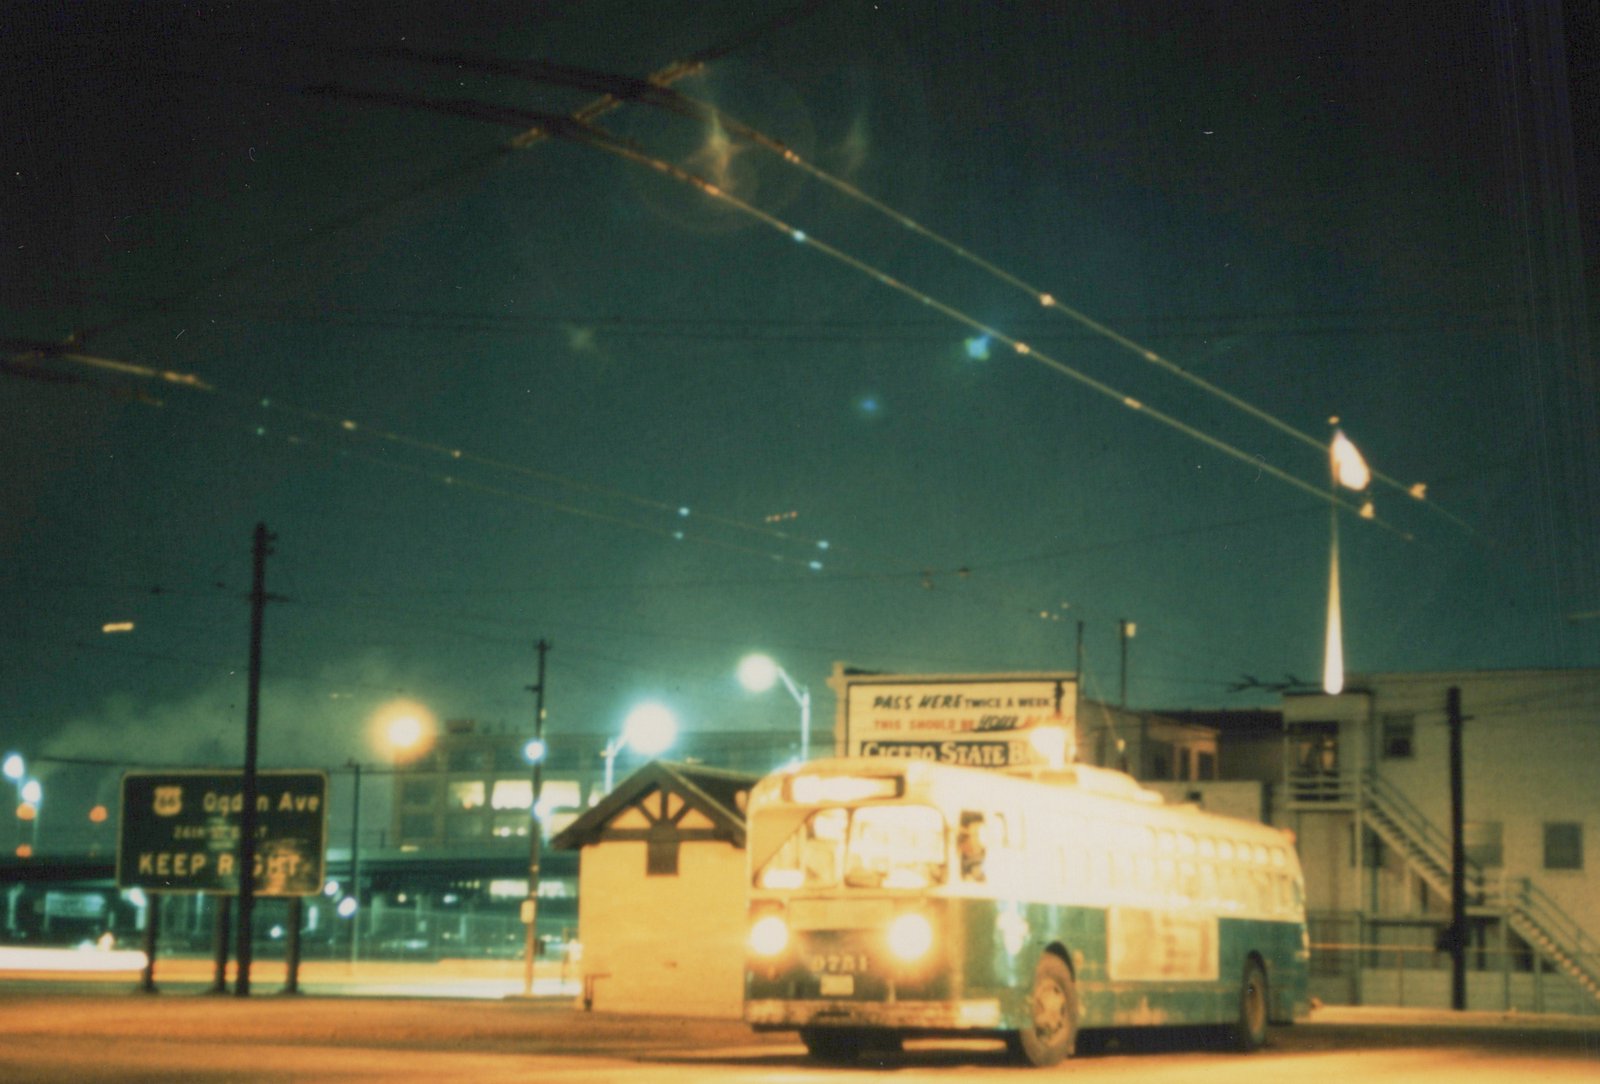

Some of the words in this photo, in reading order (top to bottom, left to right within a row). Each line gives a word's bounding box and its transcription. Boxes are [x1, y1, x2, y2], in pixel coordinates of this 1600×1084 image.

[873, 695, 912, 710] PASS
[918, 694, 964, 710] HERE
[965, 698, 1002, 709] TWICE
[1005, 698, 1014, 708] A
[1018, 697, 1051, 708] WEEK
[874, 720, 902, 731] THIS
[909, 719, 957, 731] SHOULD
[940, 742, 1006, 766] STATE
[203, 791, 269, 816] Ogdn
[278, 791, 320, 811] Ave
[139, 853, 206, 876] KEEP
[218, 853, 301, 876] RGHT
